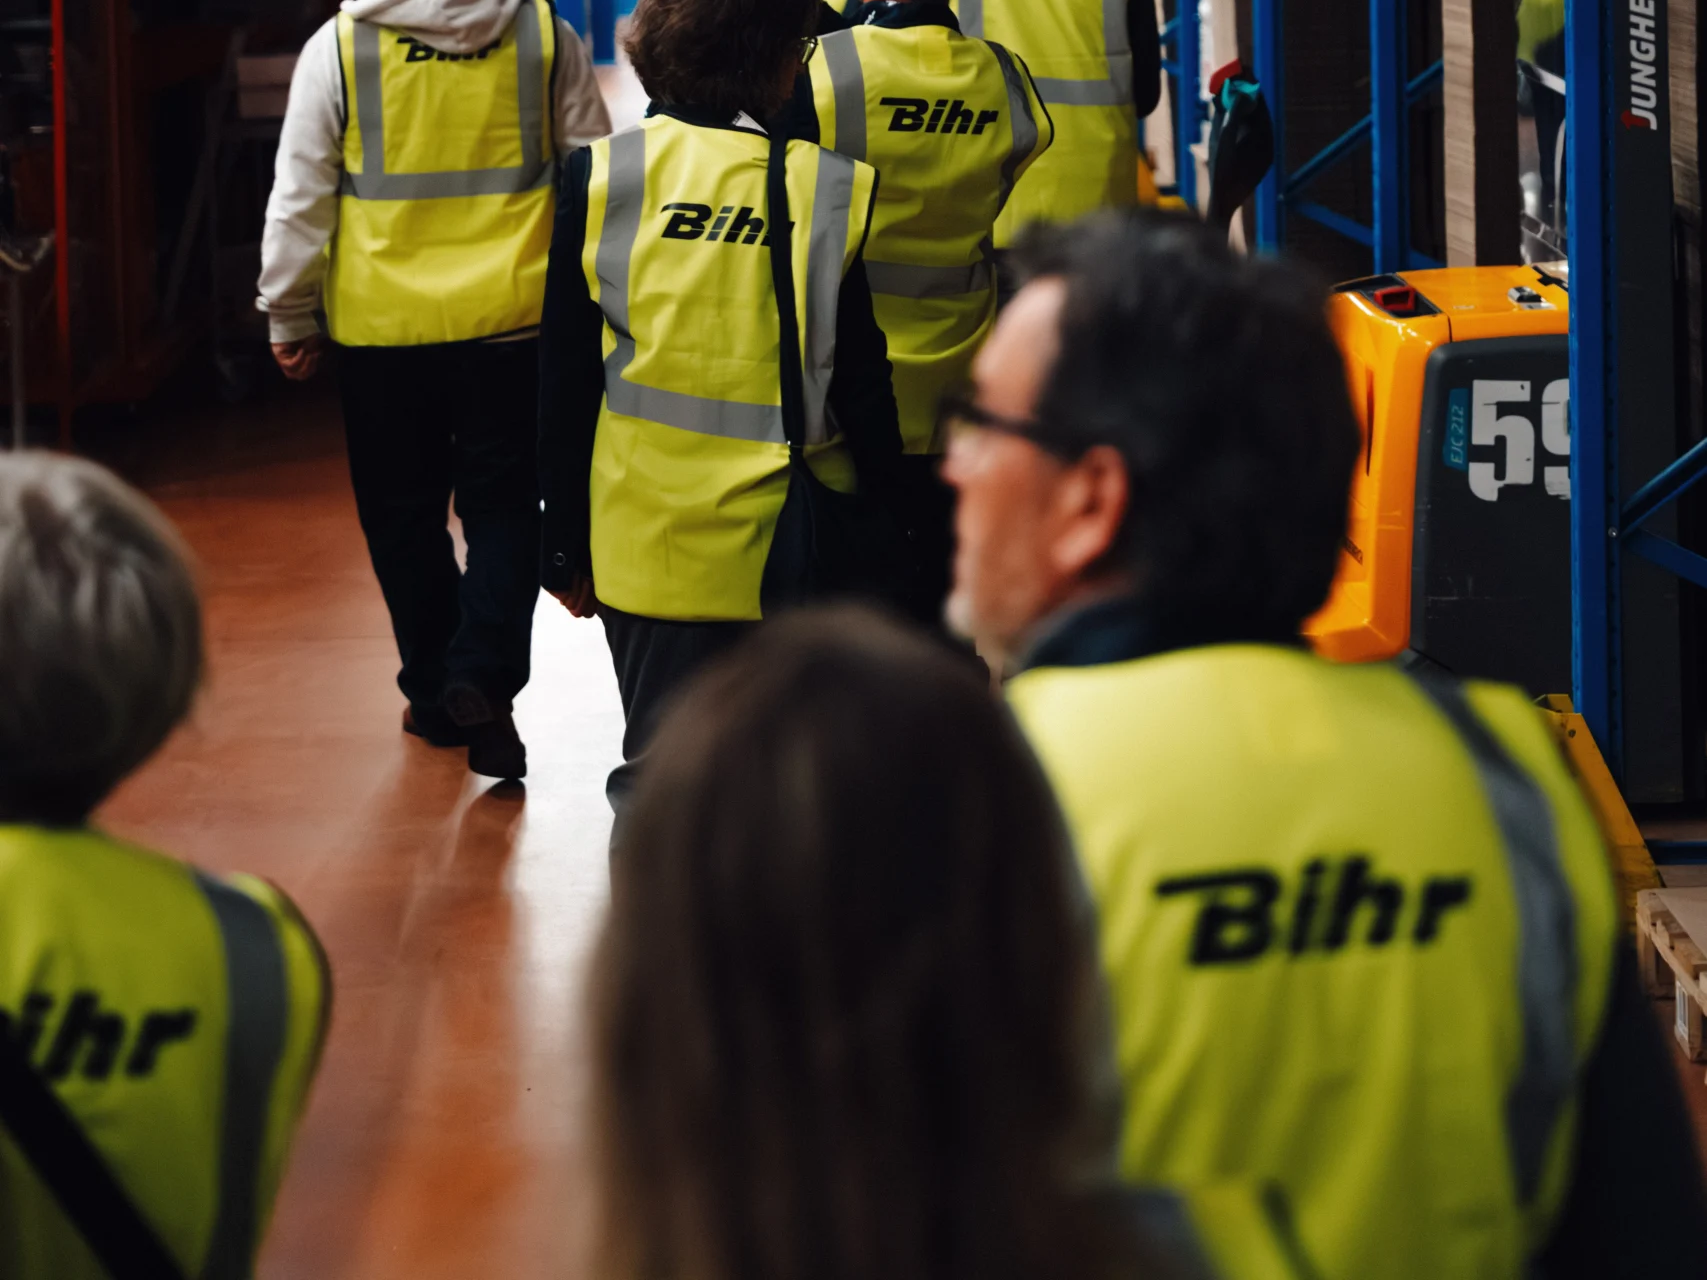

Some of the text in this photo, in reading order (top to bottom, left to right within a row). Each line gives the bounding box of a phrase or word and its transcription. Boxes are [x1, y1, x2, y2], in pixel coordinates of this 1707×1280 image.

[879, 96, 999, 135] Bihr
[1450, 405, 1465, 464] EJC 212
[1153, 853, 1474, 967] Bihr
[0, 989, 199, 1080] ihr
